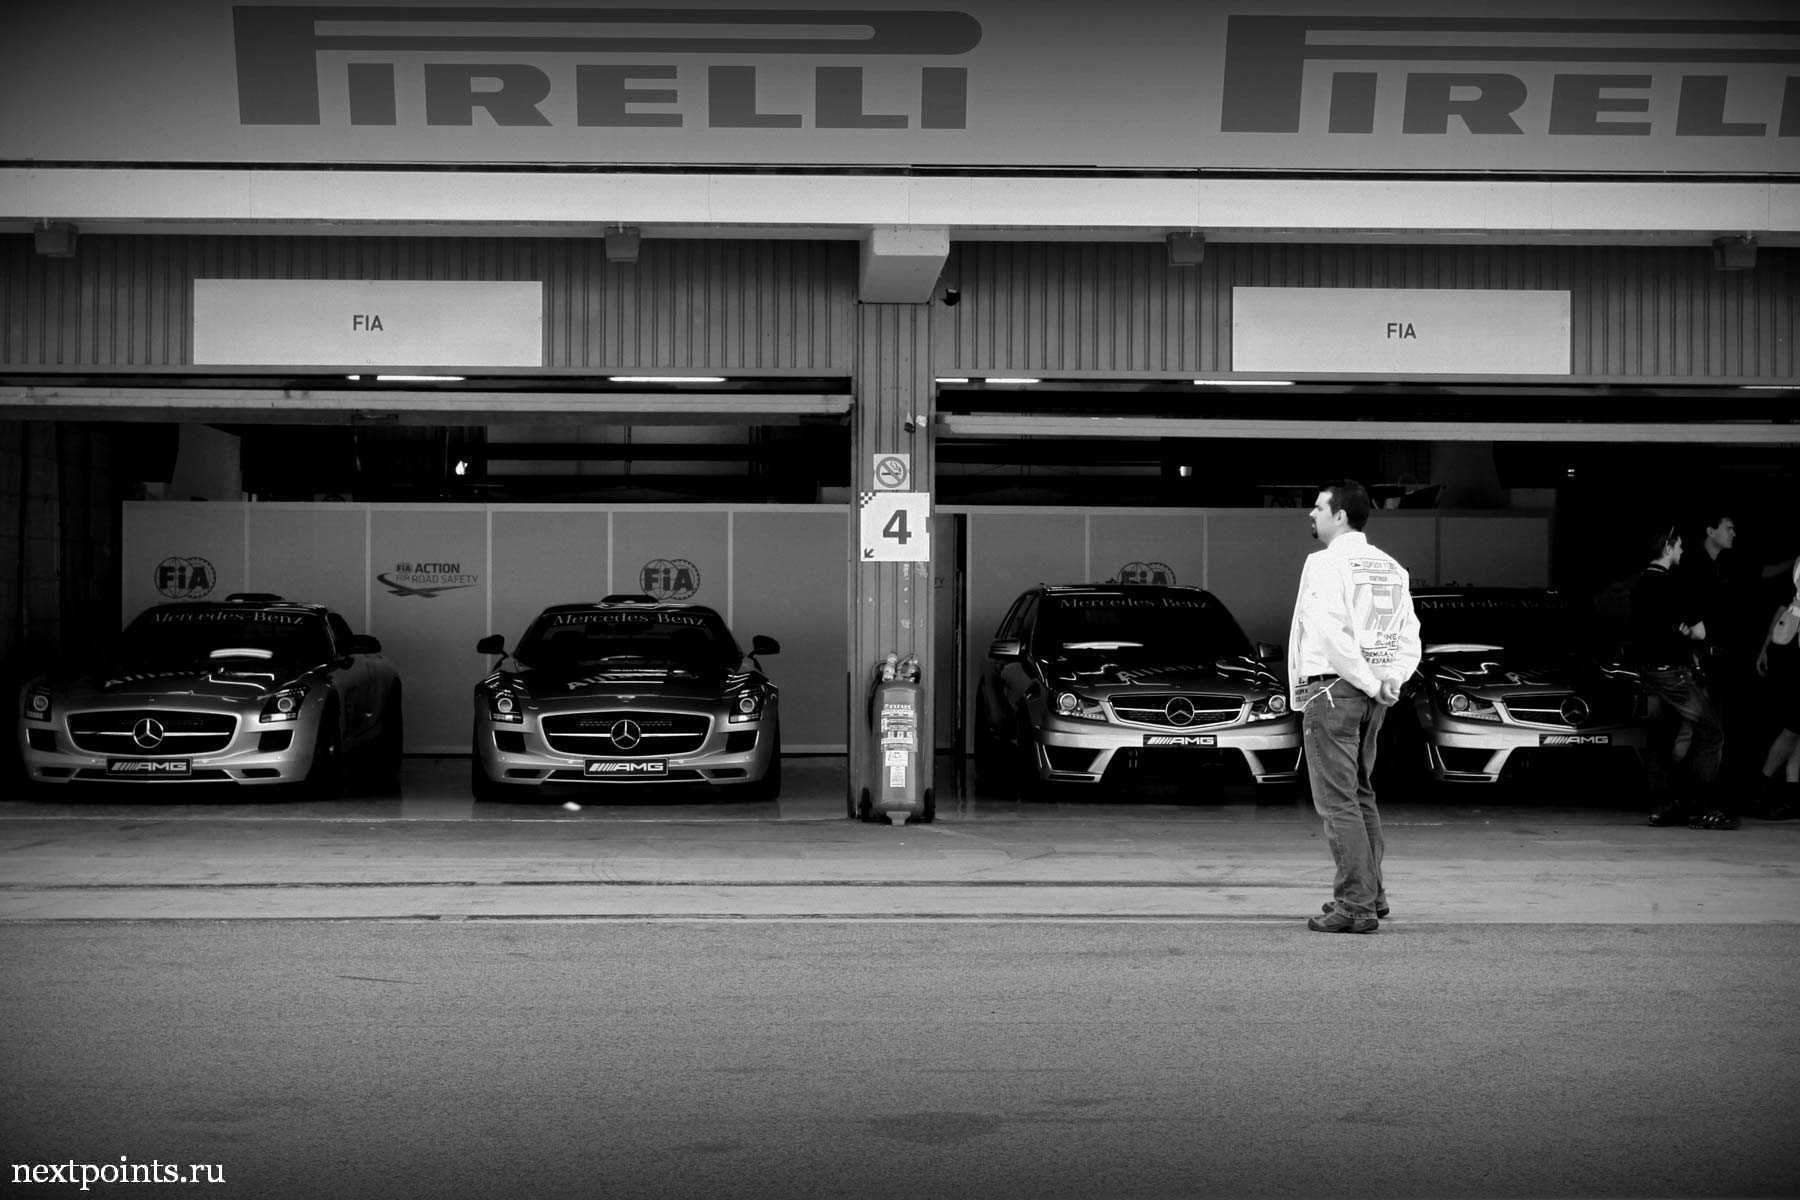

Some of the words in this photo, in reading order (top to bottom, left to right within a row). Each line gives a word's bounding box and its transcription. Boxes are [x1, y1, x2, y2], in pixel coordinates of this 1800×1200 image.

[232, 6, 982, 129] PIRELLI
[1221, 14, 1800, 137] PIREL
[353, 314, 384, 331] FIA
[1387, 322, 1417, 339] FIA
[883, 510, 912, 544] 4
[415, 563, 461, 574] ACTION
[412, 575, 439, 584] ROAD
[441, 575, 479, 585] SAFETY
[1167, 736, 1215, 746] AMG
[1563, 735, 1610, 746] AMG
[133, 761, 188, 772] AMG
[610, 762, 665, 772] AMG
